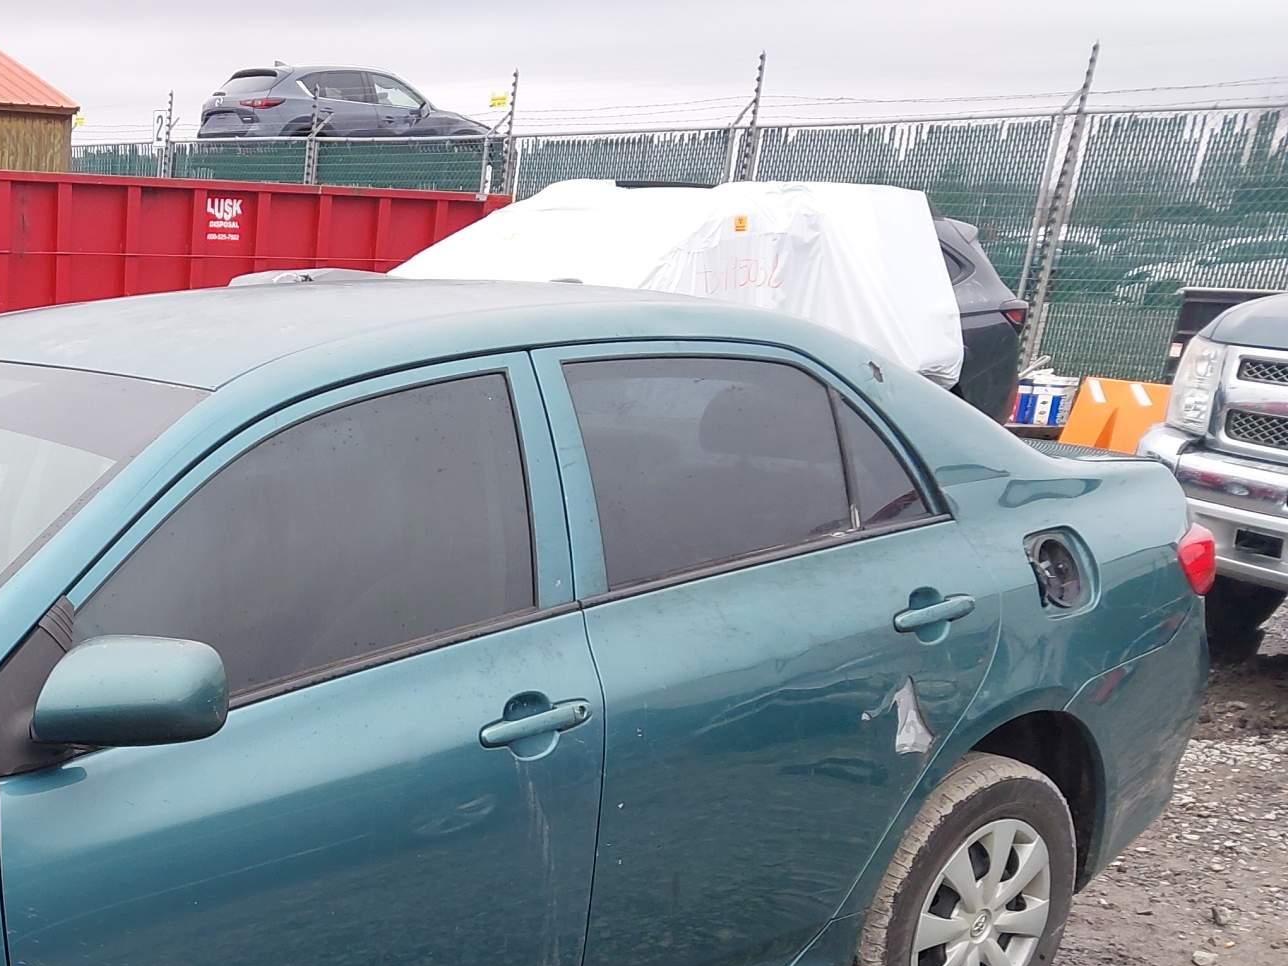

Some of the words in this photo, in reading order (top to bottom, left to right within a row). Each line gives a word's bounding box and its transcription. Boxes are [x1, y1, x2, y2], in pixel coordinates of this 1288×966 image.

[156, 114, 164, 142] 2
[207, 198, 243, 220] LUSK
[209, 220, 240, 229] DISPOSAL
